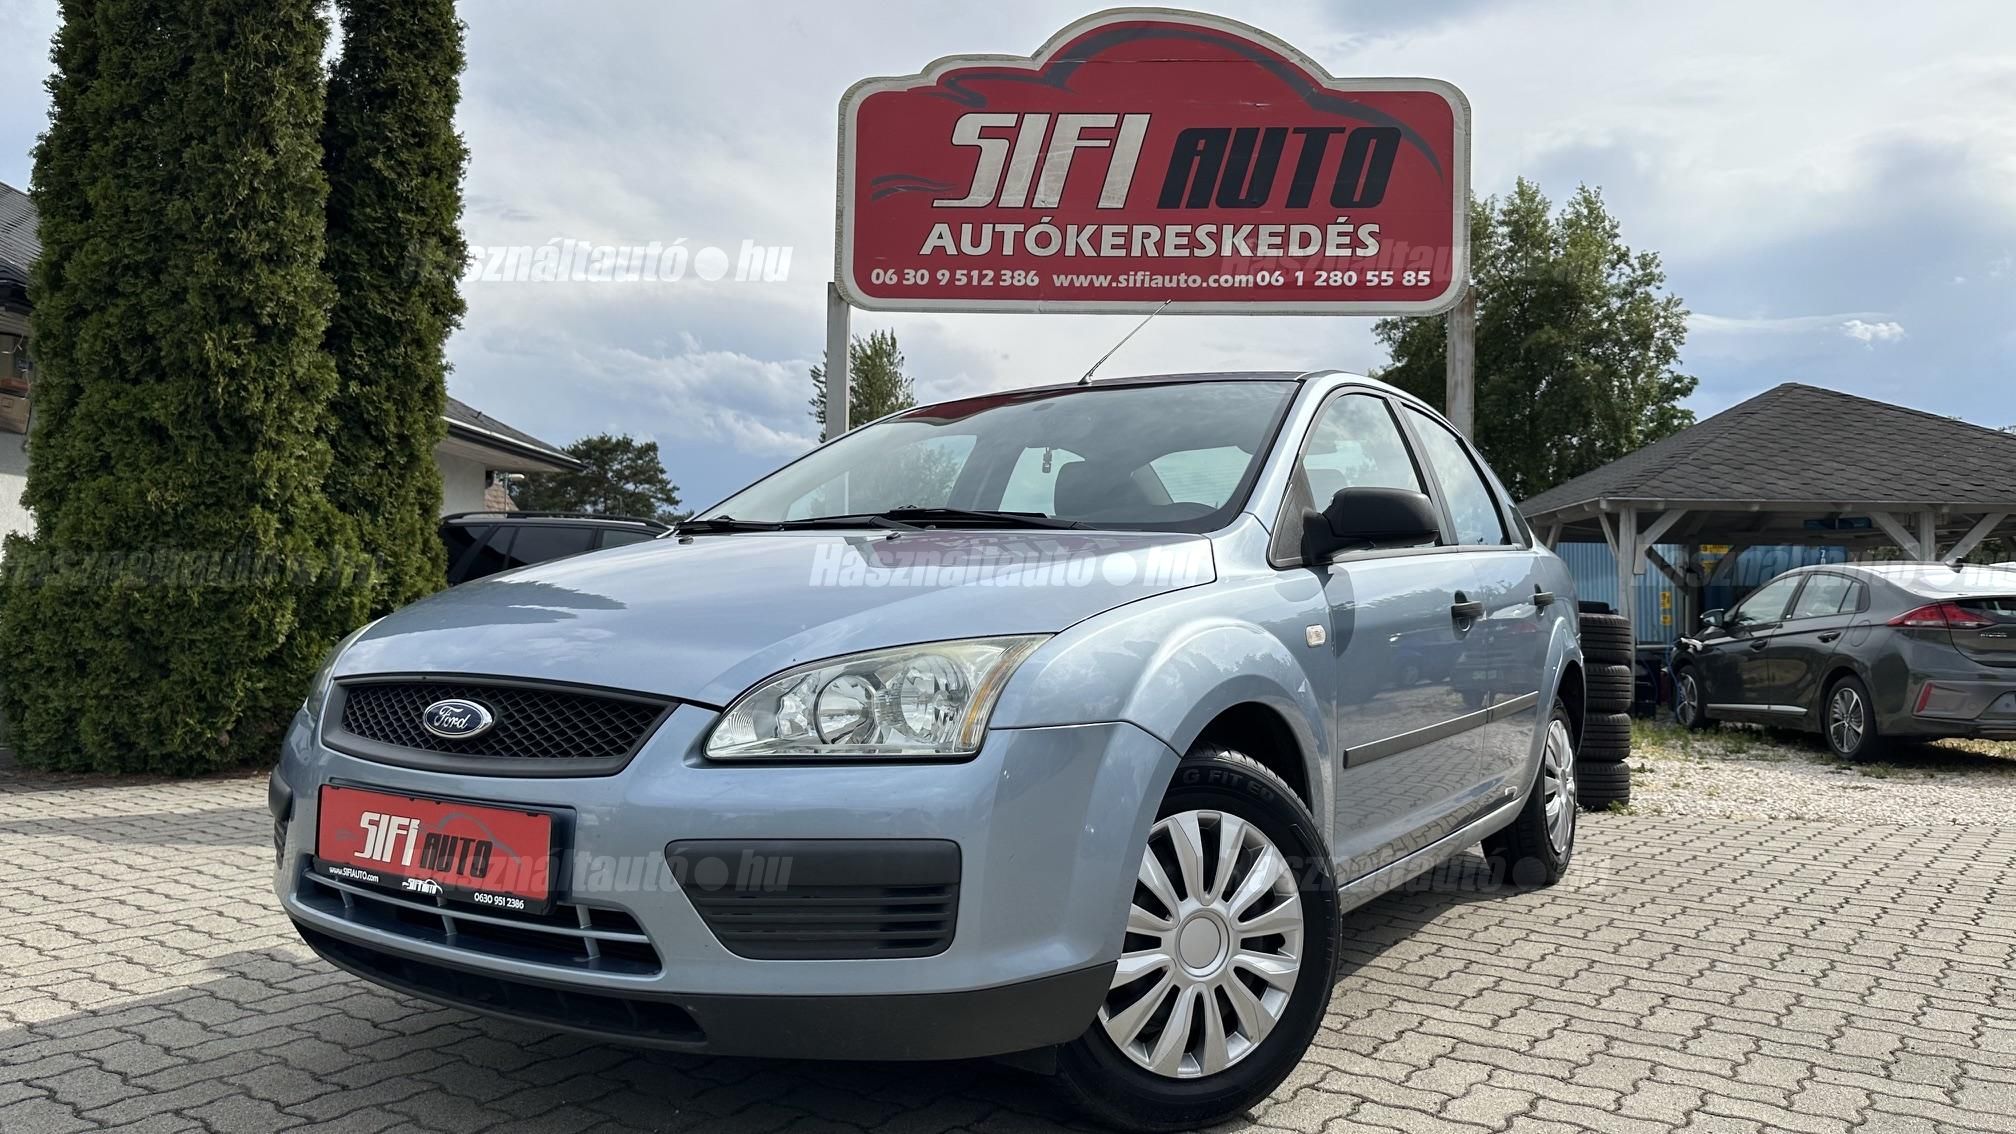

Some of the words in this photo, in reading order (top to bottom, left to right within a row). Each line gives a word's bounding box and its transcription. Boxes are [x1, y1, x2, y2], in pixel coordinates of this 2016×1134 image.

[932, 112, 1151, 210] SIFI
[1157, 126, 1402, 210] AUTO
[919, 216, 1382, 258] AUTÓKERESKEDÉS
[870, 268, 898, 286] 06
[902, 268, 930, 286] 30
[999, 269, 1040, 287] 386
[1051, 270, 1254, 288] www.sifiauto.com
[1256, 270, 1285, 287] 06
[1294, 270, 1304, 286] 1
[1314, 270, 1358, 287] 280
[1366, 270, 1394, 287] 55
[1402, 270, 1432, 287] 85
[433, 705, 471, 729] Ford
[354, 811, 421, 866] SIFI
[419, 832, 493, 879] AUTO
[474, 892, 493, 905] 0630
[493, 895, 507, 907] 951
[506, 896, 525, 909] 2386
